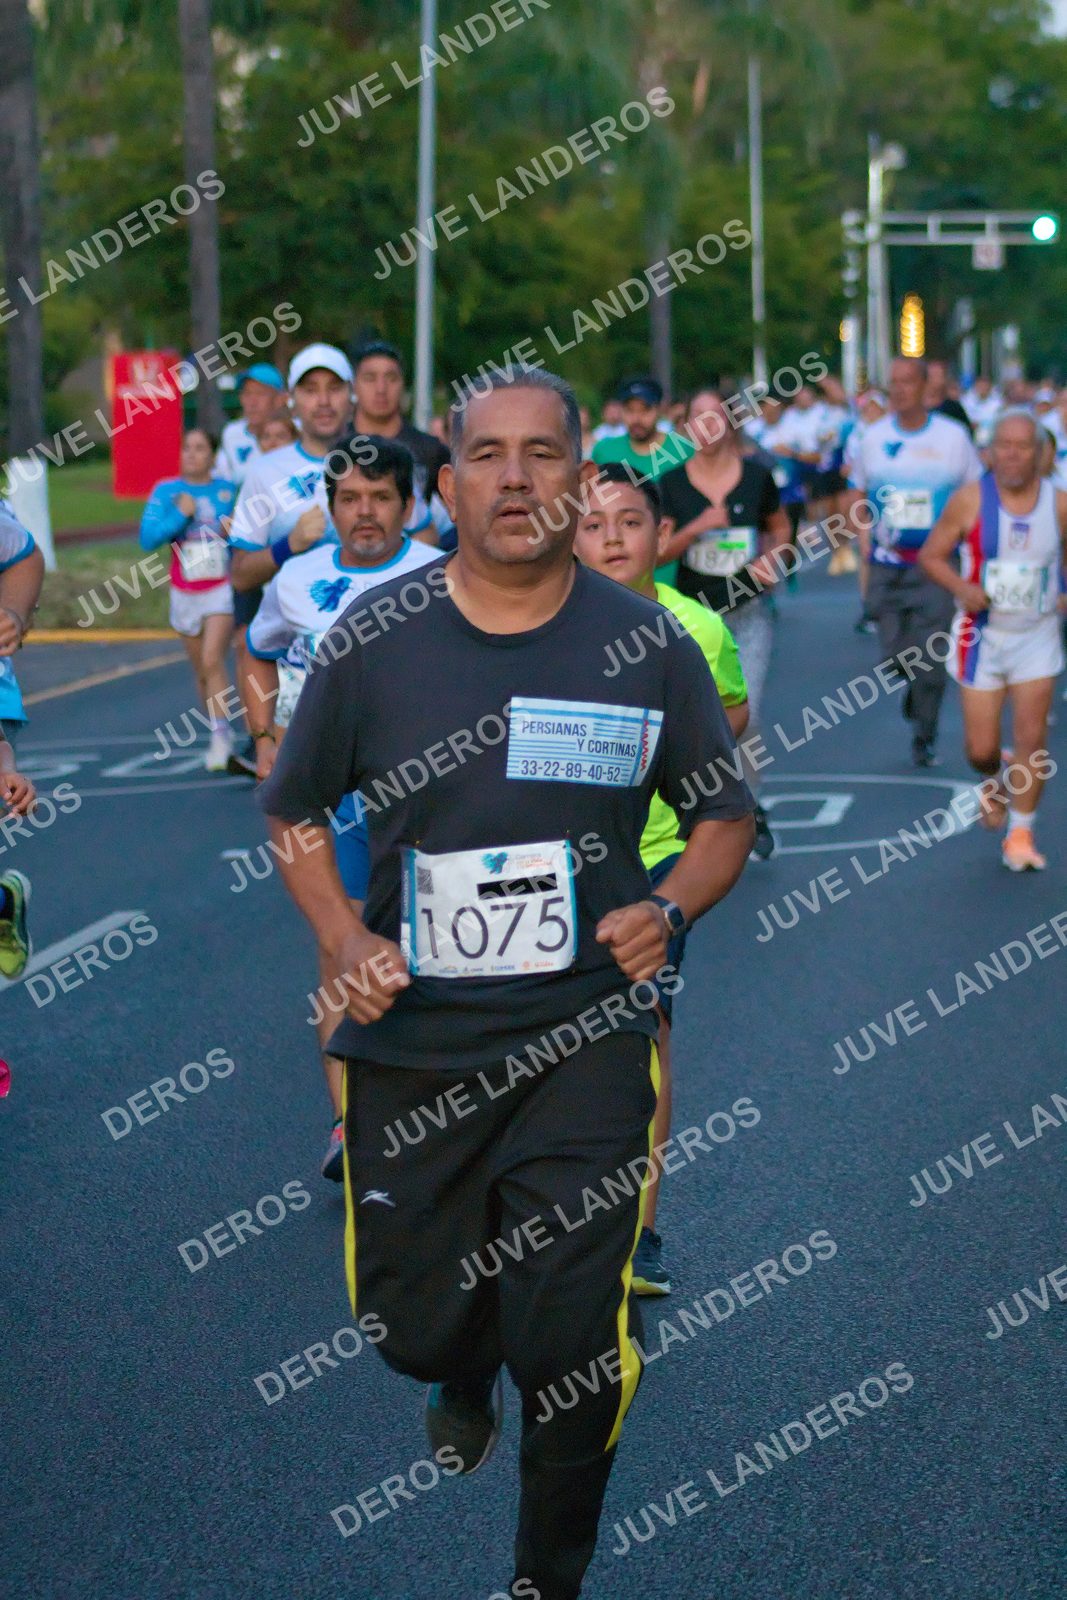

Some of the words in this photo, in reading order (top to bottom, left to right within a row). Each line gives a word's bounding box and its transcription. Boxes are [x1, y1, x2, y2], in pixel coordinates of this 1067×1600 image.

[522, 720, 587, 736] PERSIANAS
[577, 738, 586, 752] Y
[588, 739, 637, 758] CORTINAS
[520, 759, 621, 782] 33-22-89-40-52
[421, 896, 569, 960] 1075
